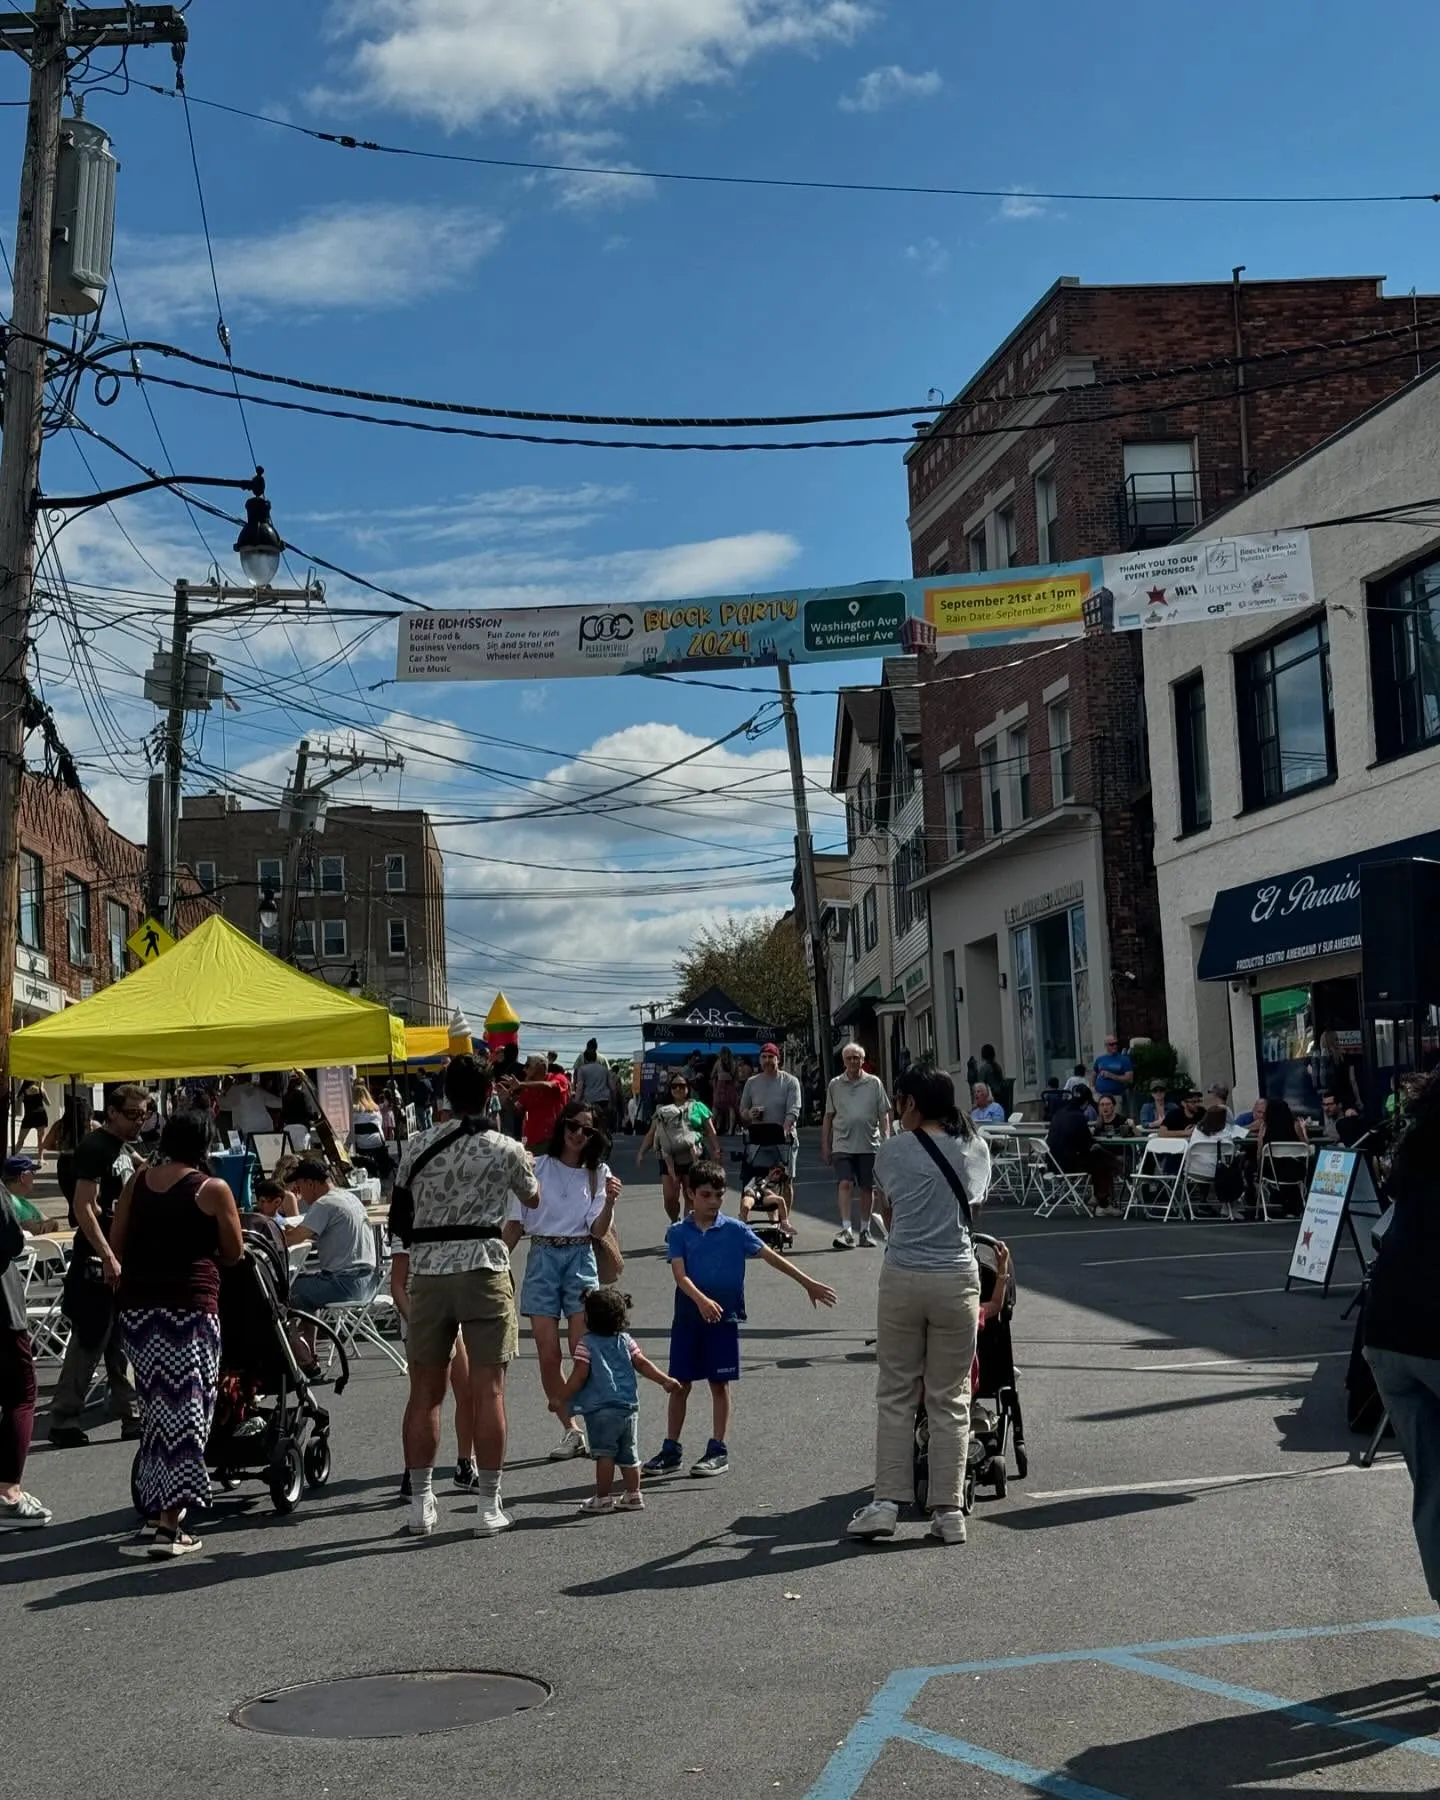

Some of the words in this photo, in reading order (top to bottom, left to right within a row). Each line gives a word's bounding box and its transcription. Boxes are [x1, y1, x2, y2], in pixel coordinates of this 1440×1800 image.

[1119, 563, 1146, 574] THANK
[1148, 559, 1166, 569] YOU
[1167, 558, 1179, 566] TO
[1180, 555, 1198, 565] OUR
[1124, 570, 1150, 581] EVENT
[1151, 565, 1195, 577] SPONSORS
[940, 596, 1005, 611] September
[1007, 592, 1032, 604] 21st
[1034, 592, 1047, 601] at
[1050, 587, 1076, 600] 1pm
[644, 604, 712, 632] BLOCK
[720, 599, 798, 625] PARTY
[946, 613, 967, 623] Rain
[996, 606, 1047, 620] September
[1050, 602, 1071, 612] 28th
[409, 618, 434, 630] FREE
[438, 617, 502, 629] ADMISSION
[810, 618, 875, 634] Washington
[877, 616, 898, 626] Ave
[409, 632, 431, 641] Local
[432, 632, 453, 641] Food
[454, 632, 461, 640] &
[487, 631, 502, 640] Fun
[504, 631, 525, 639] Zone
[528, 630, 541, 639] for
[543, 629, 560, 638] Kids
[815, 637, 823, 646] &
[825, 632, 871, 645] Wheeler
[873, 631, 894, 641] Ave
[409, 643, 444, 652] Business
[446, 642, 480, 651] Vendors
[486, 640, 499, 651] Sip
[501, 641, 517, 649] and
[518, 640, 542, 649] Stroll
[687, 629, 749, 657] 2024
[409, 654, 423, 663] Car
[425, 653, 447, 662] Show
[486, 651, 521, 661] Wheeler
[522, 651, 555, 660] Avenue
[408, 665, 425, 674] Live
[427, 664, 451, 673] Music
[1250, 885, 1282, 923] El
[1280, 873, 1361, 916] Paraiso
[1236, 954, 1264, 970] PRODUCTOS
[1265, 952, 1285, 965] CENTRO
[1286, 943, 1317, 961] AMERICANO
[1317, 942, 1323, 954] Y
[1322, 939, 1334, 953] SUR
[684, 1007, 744, 1025] ARC
